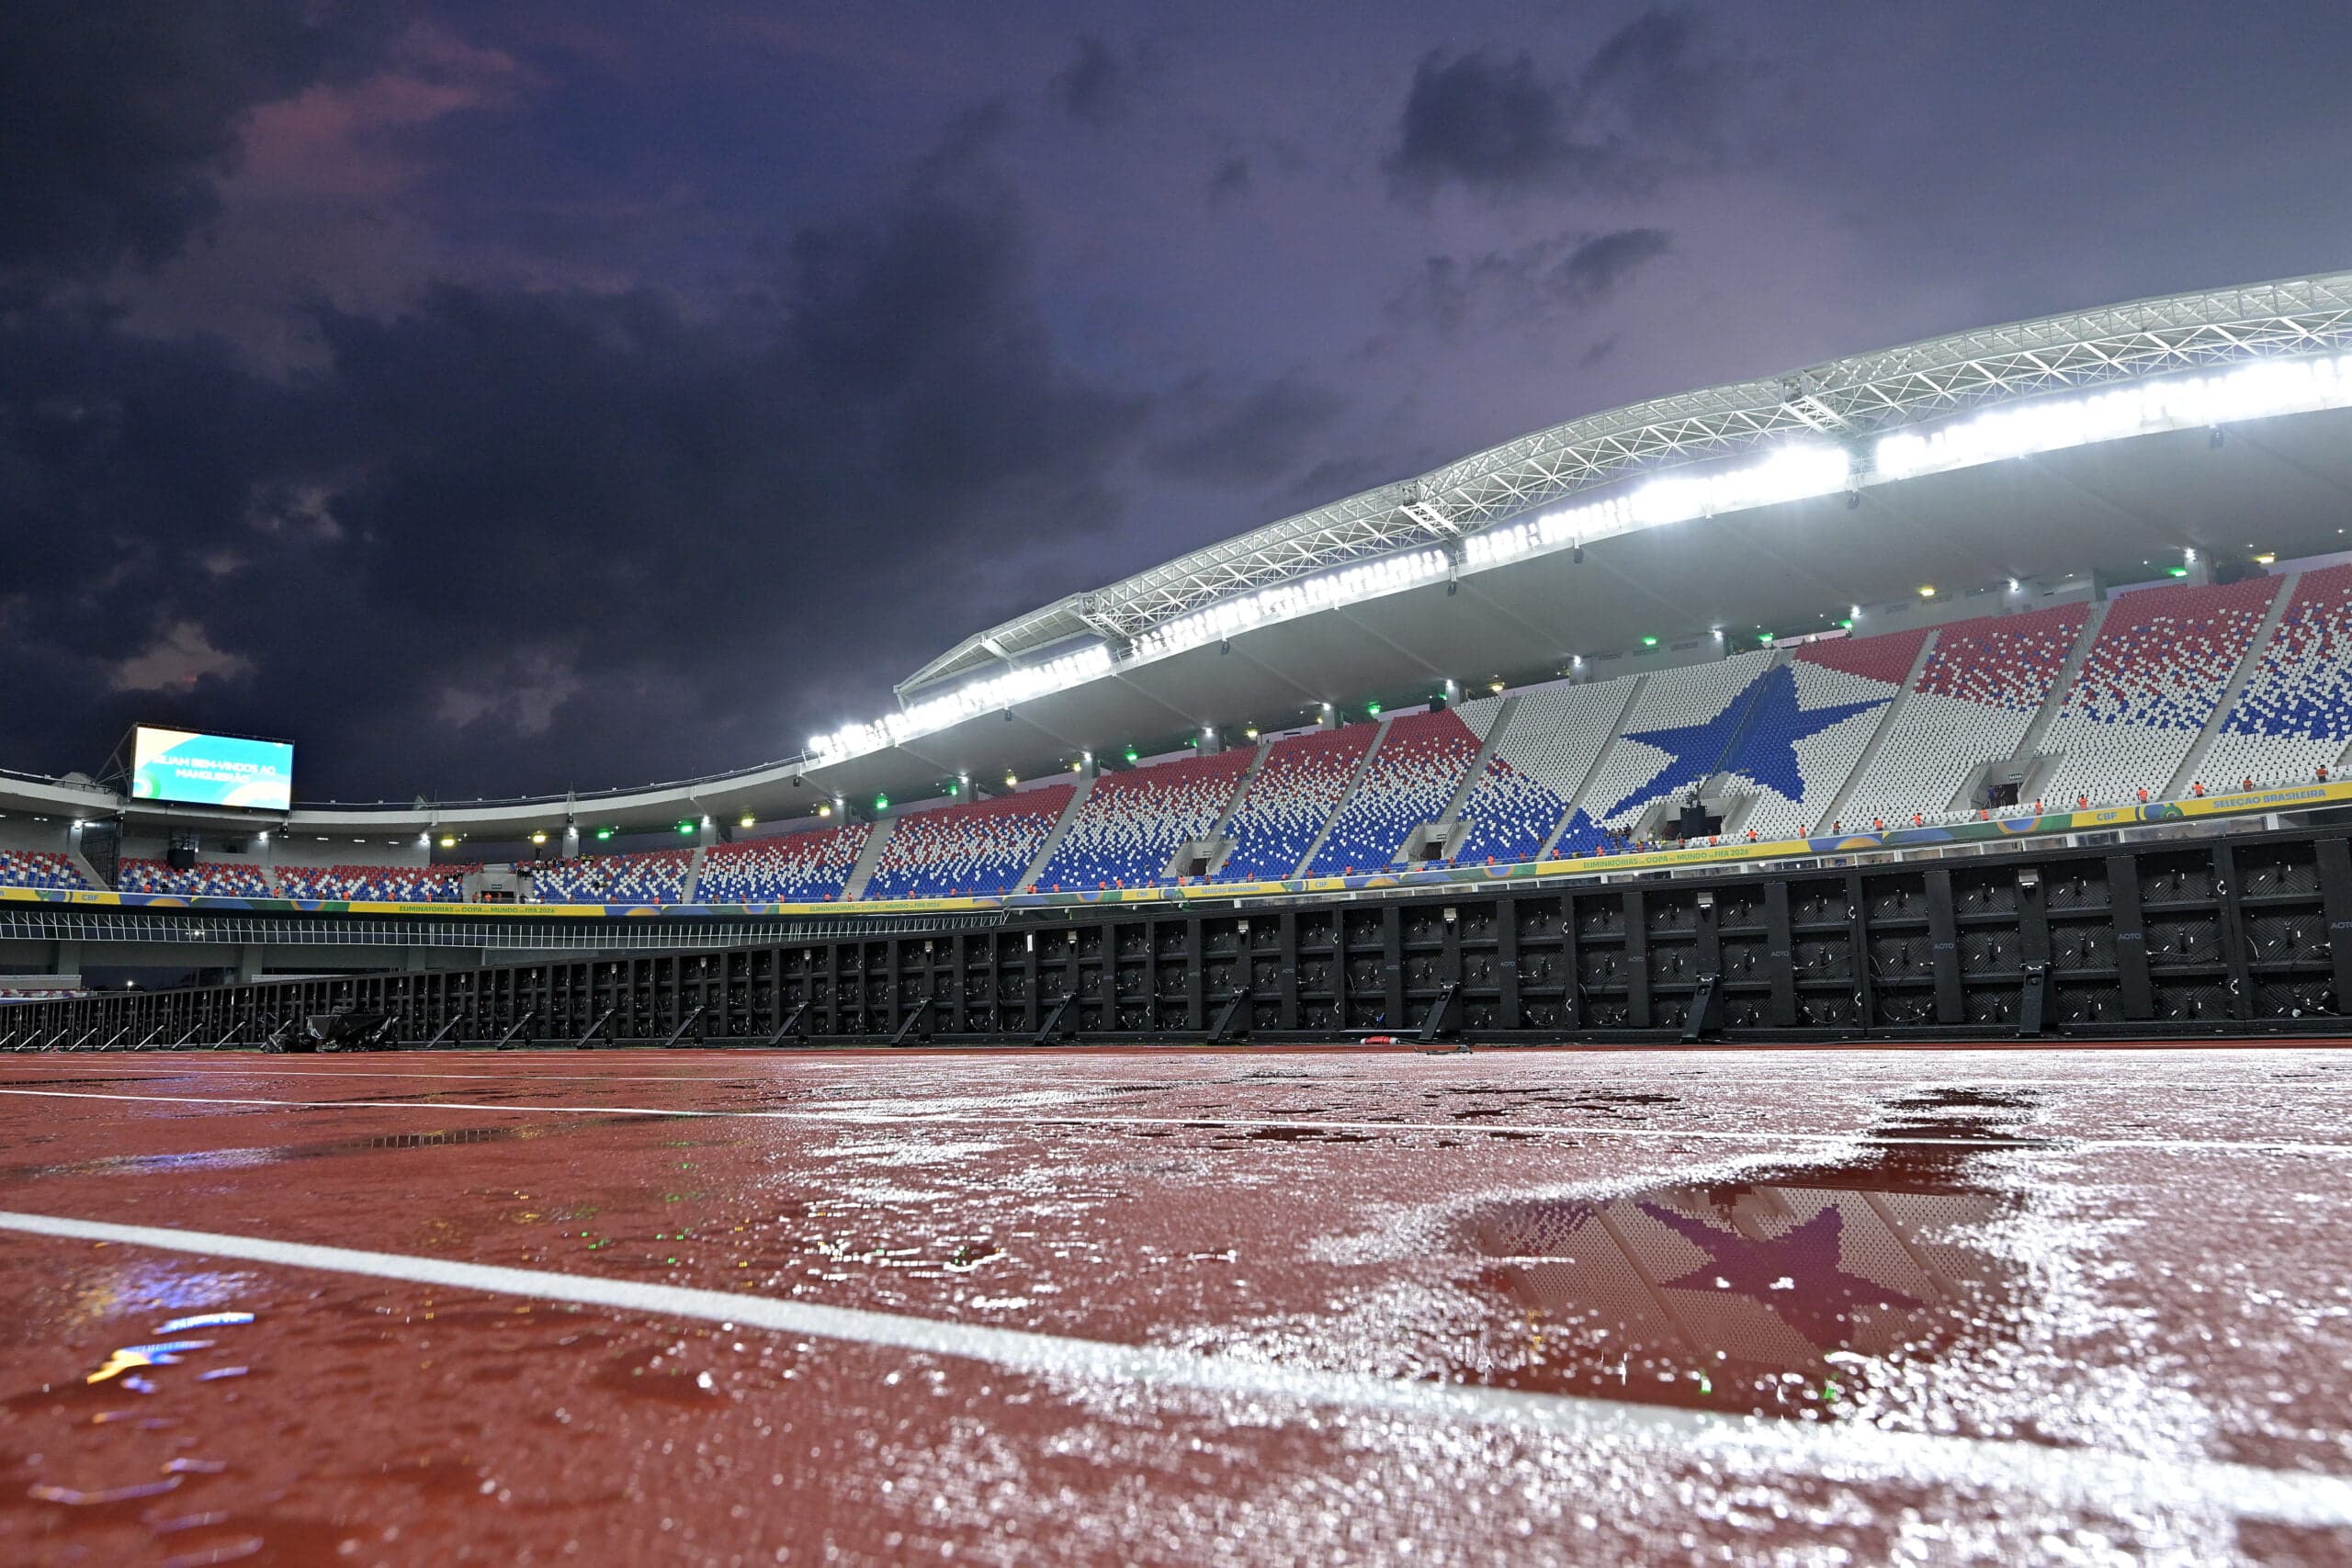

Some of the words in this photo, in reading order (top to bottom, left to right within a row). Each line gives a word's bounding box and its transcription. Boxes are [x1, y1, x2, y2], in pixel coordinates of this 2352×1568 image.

[2263, 789, 2326, 803] BRASILEIRA
[2097, 811, 2118, 821] CBF
[1645, 855, 1668, 864] COPA
[1677, 852, 1707, 862] MUNDO
[1714, 850, 1729, 858] FIFA
[2118, 932, 2142, 941] AOTO
